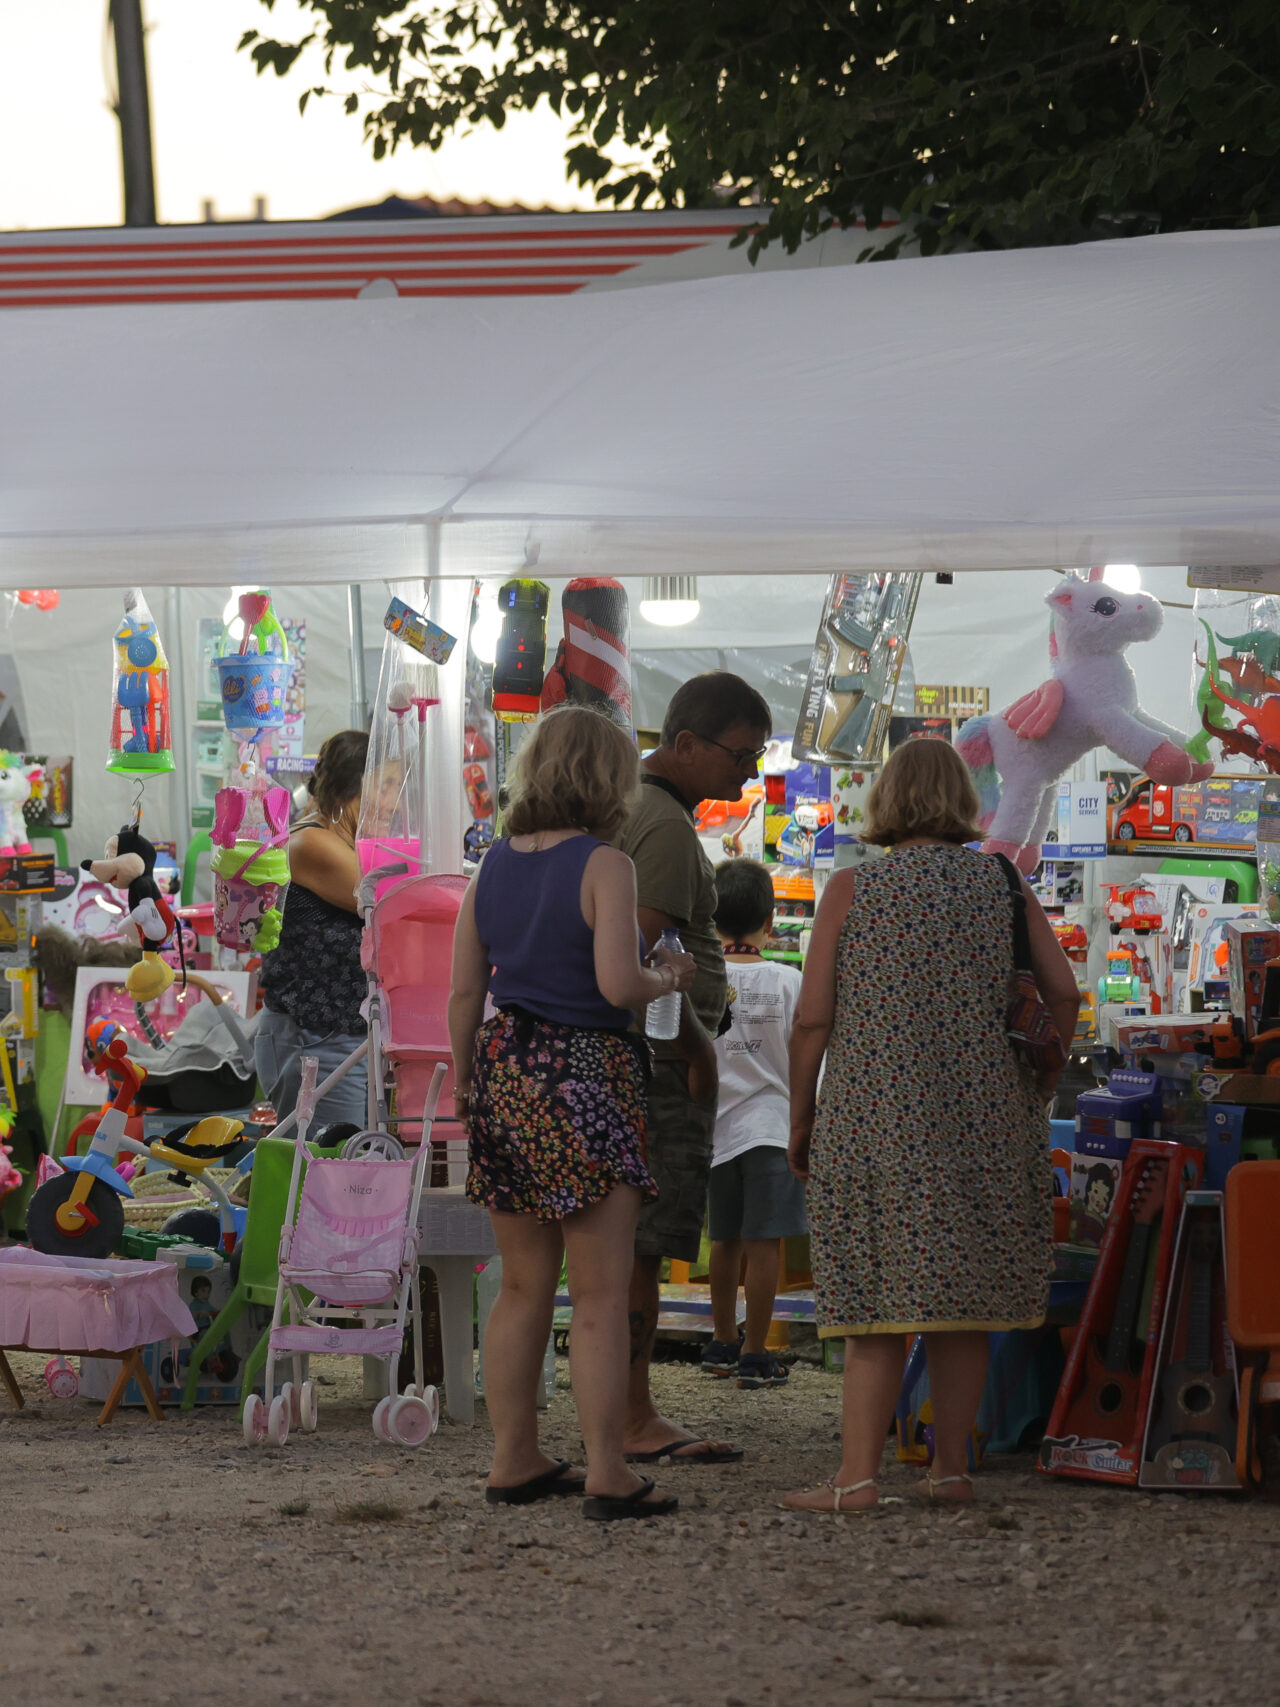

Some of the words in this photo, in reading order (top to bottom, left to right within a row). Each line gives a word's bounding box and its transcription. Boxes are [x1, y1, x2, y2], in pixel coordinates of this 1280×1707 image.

[806, 667, 826, 719] FLYING
[800, 721, 815, 747] FUN
[276, 758, 304, 772] RACING
[1078, 797, 1099, 808] CITY
[349, 1185, 373, 1195] Niza
